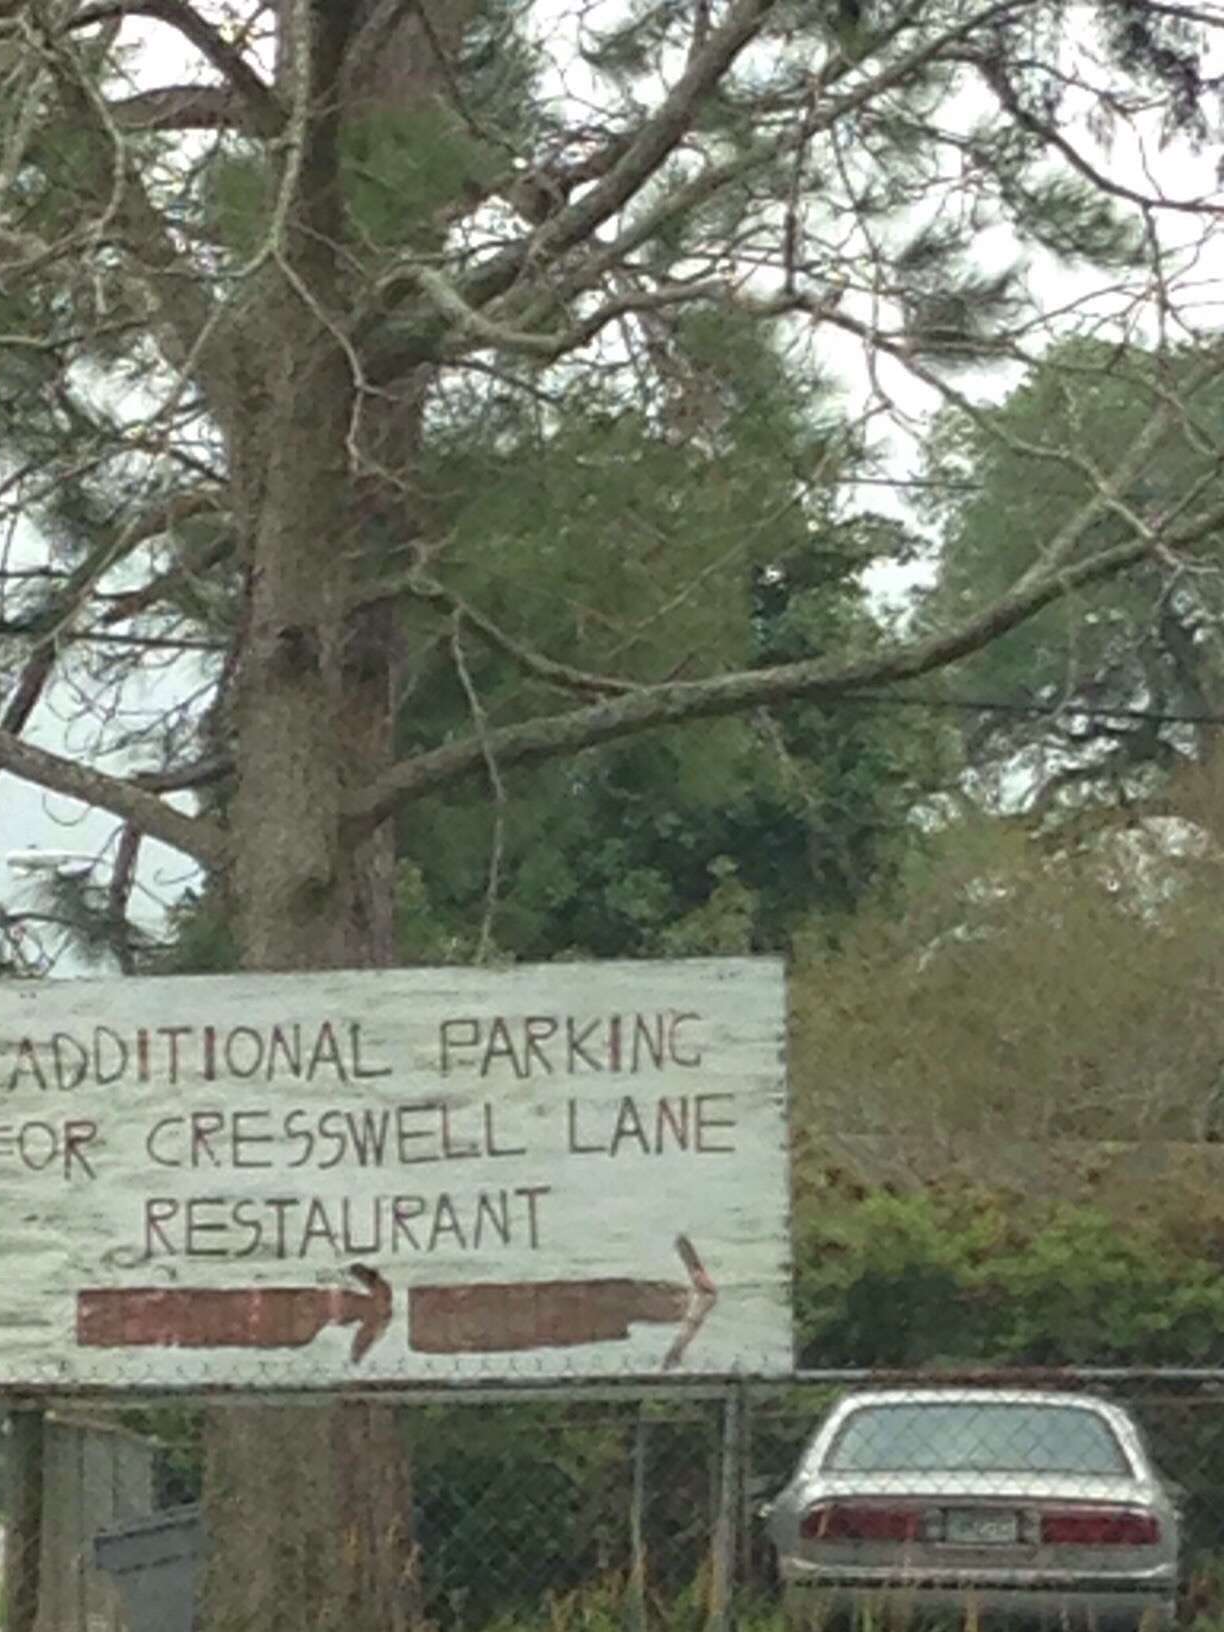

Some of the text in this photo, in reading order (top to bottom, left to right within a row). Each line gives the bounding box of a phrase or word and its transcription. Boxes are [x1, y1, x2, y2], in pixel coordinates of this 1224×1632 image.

[9, 1020, 392, 1092] ADDITIONAL
[147, 1101, 526, 1169] CRESSWELL
[569, 1092, 737, 1154] LANE
[143, 1186, 551, 1258] RESTAURANT
